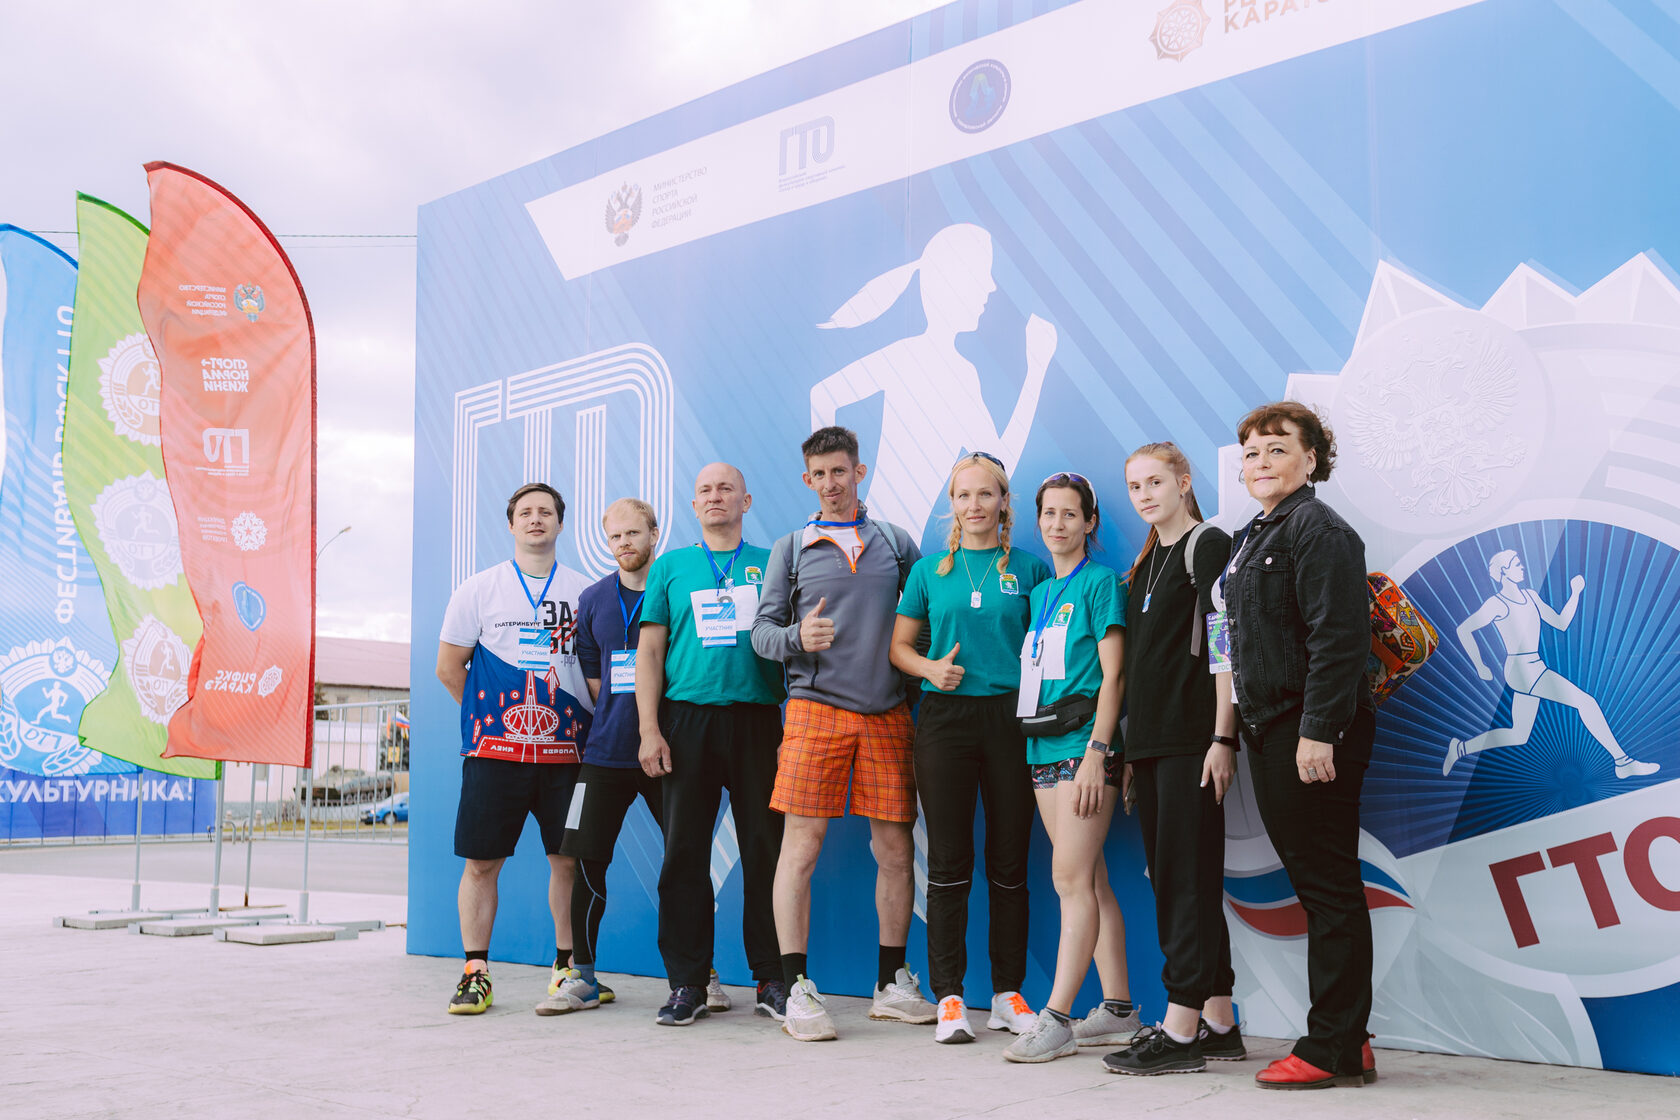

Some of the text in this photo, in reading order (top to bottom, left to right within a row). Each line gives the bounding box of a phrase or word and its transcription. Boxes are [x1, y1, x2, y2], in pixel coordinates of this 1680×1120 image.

[1225, 0, 1328, 33] КАРА
[779, 115, 835, 176] ГТО
[653, 166, 708, 192] МИНИСТЕРСТВО
[652, 189, 679, 204] СПОРТА
[652, 193, 698, 216] РОССИЙСКОЙ
[452, 342, 674, 598] ГТО
[542, 600, 573, 626] ЗА
[1489, 816, 1680, 949] ГТО
